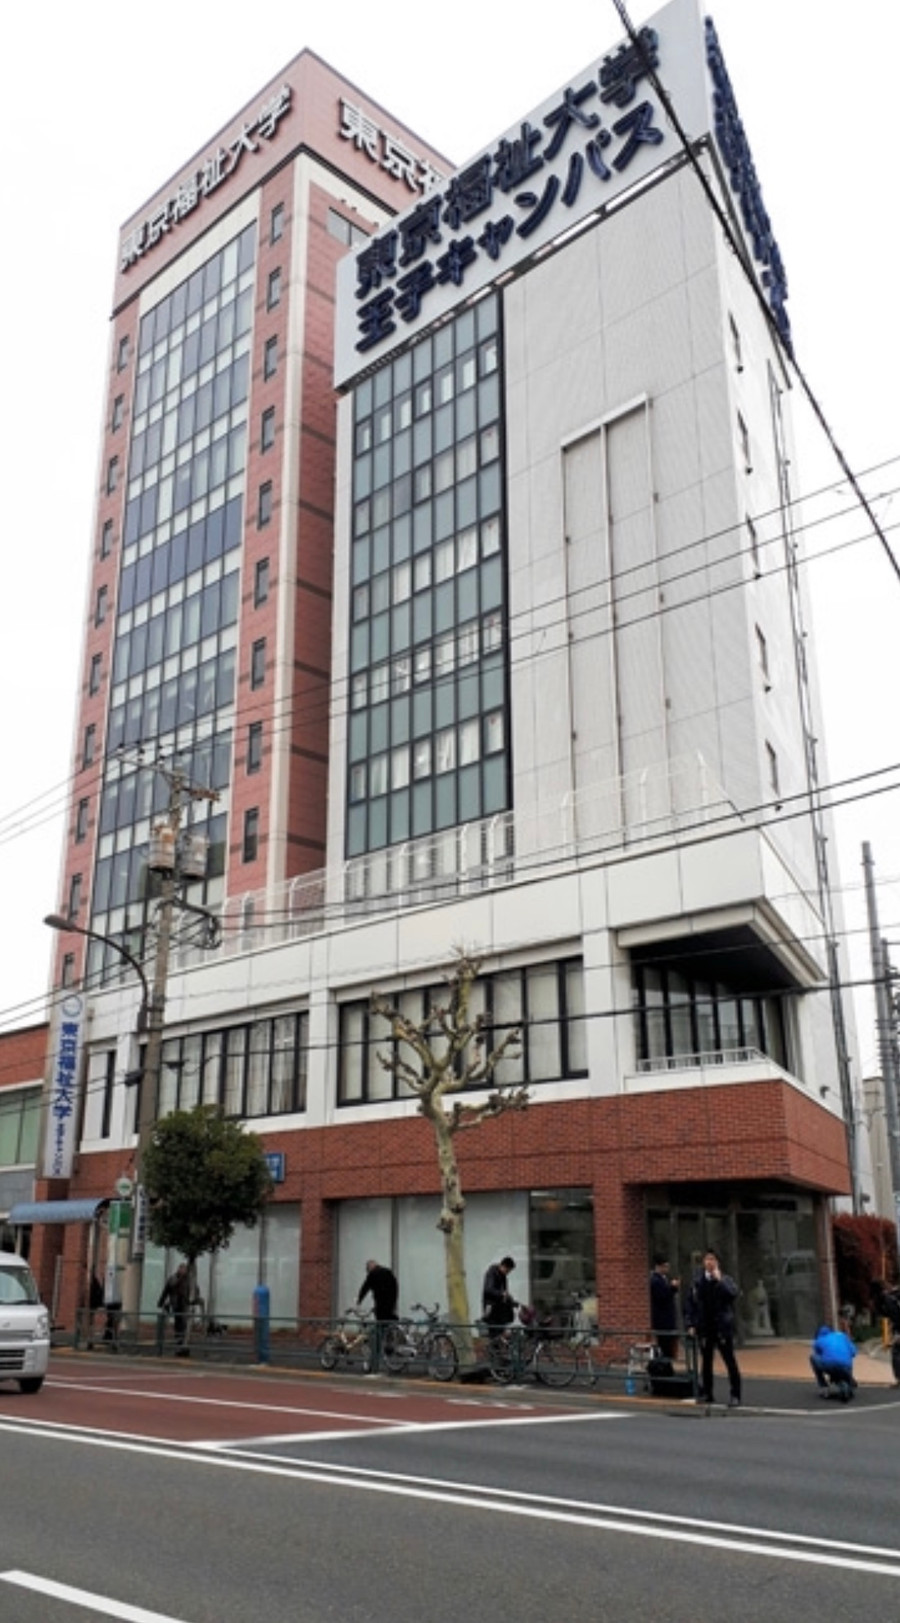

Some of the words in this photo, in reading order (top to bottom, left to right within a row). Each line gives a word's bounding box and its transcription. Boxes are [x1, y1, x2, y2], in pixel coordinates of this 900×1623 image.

[121, 84, 291, 274] 東京福祉大学
[356, 26, 658, 299] 東京福祉大学
[356, 101, 664, 353] 王子キャンパス
